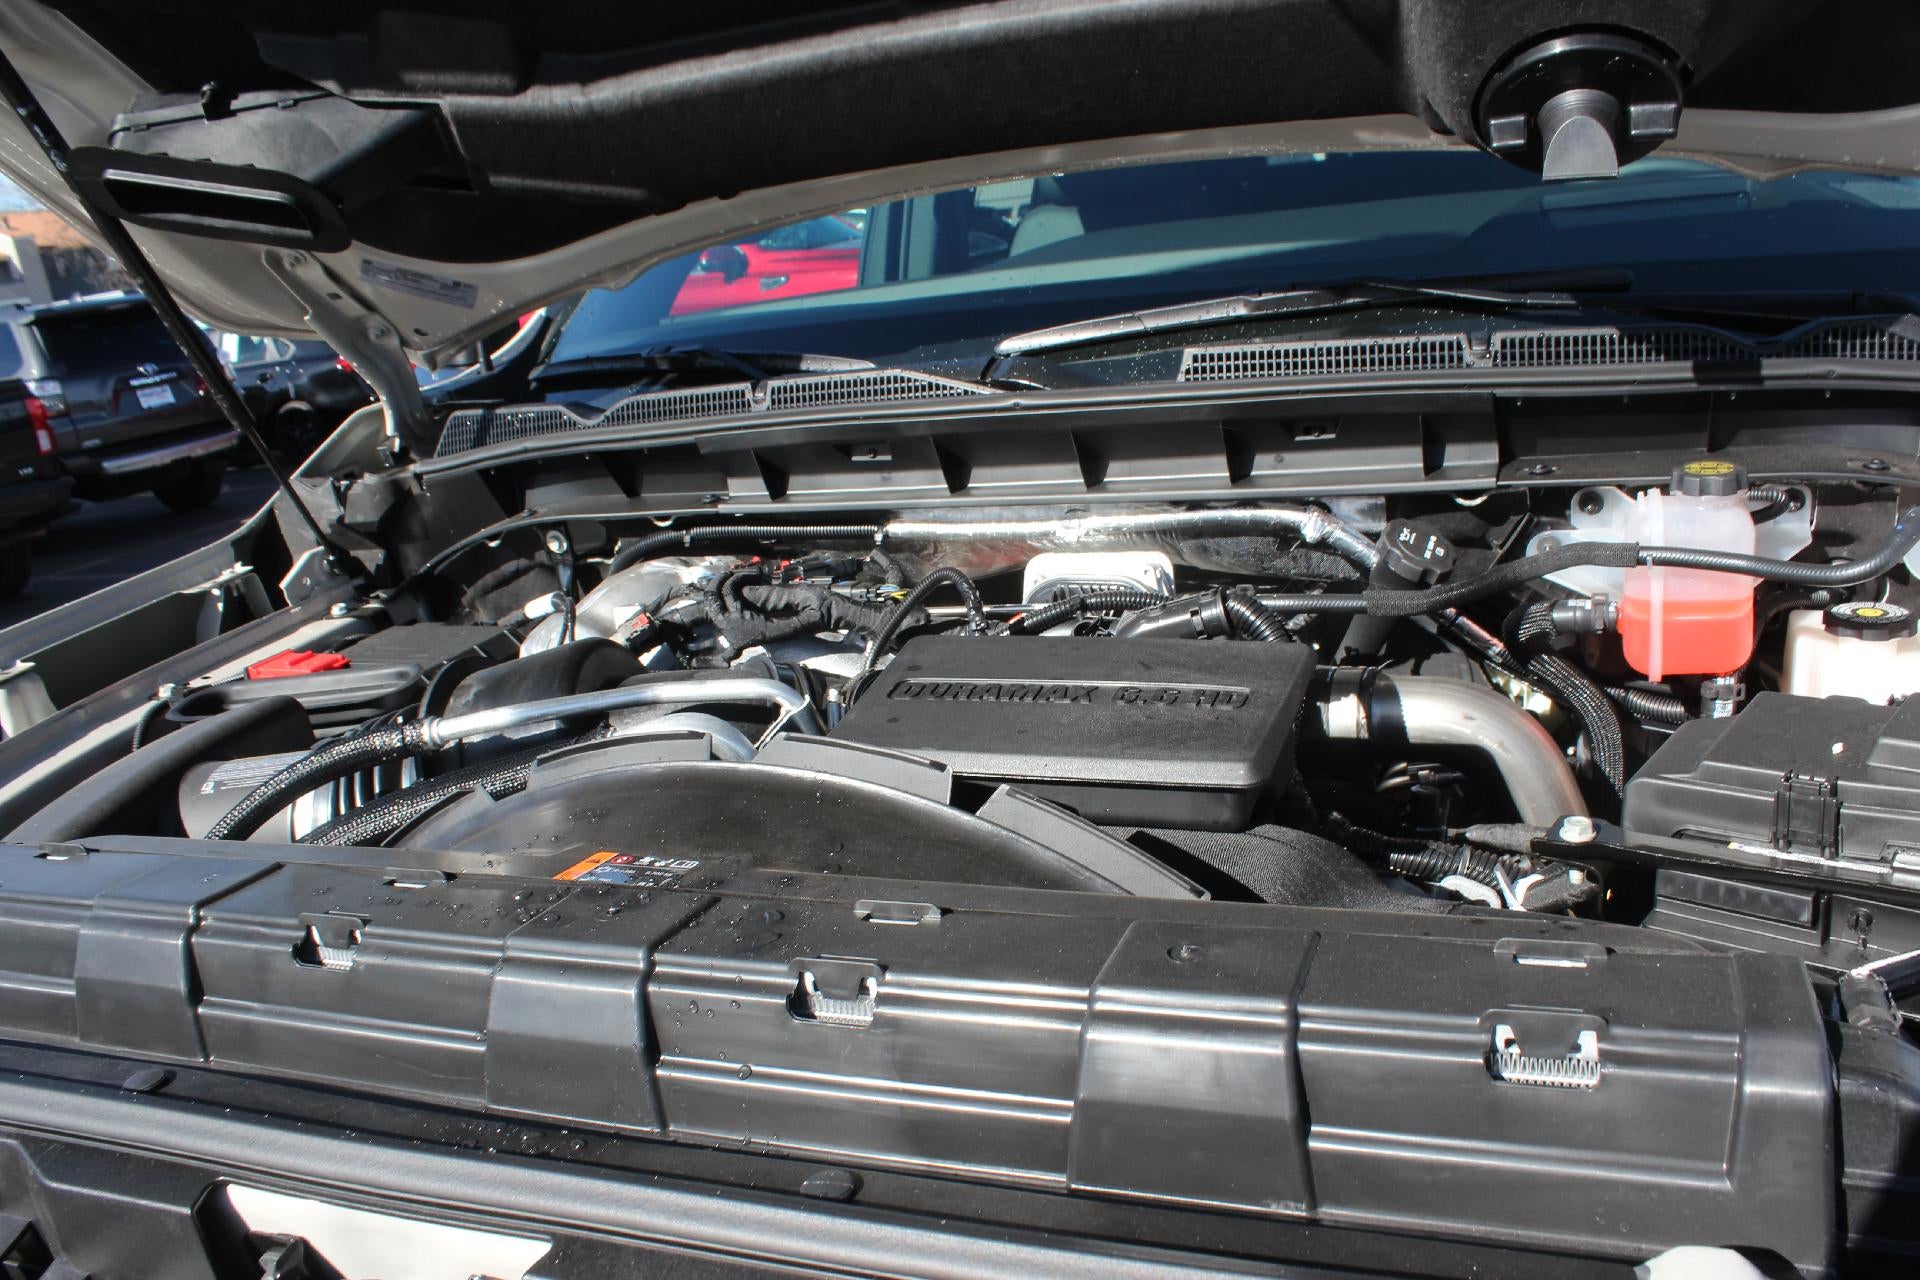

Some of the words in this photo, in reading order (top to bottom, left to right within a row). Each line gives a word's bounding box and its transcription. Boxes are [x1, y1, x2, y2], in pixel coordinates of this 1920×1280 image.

[886, 680, 1099, 704] DURAMAX
[1112, 686, 1182, 706] 6.6
[1188, 689, 1250, 709] HD
